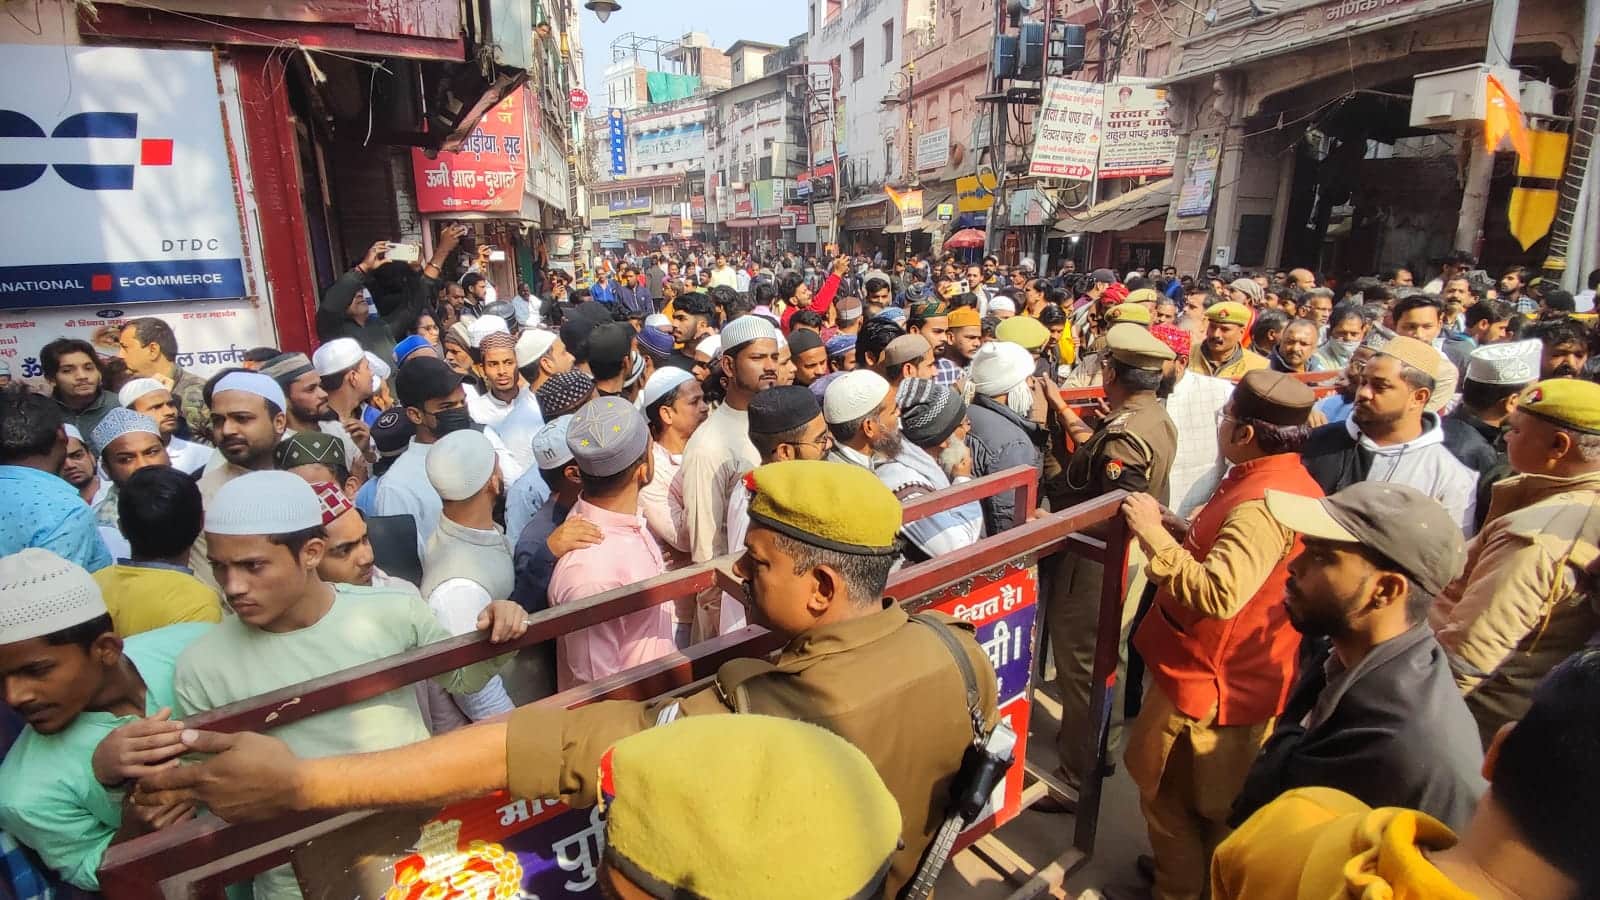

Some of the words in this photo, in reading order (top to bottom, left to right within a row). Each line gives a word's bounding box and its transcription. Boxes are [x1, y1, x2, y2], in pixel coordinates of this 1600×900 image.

[1109, 110, 1151, 119] सरदार
[503, 135, 521, 162] सूट
[424, 162, 449, 188] ऊनी
[162, 238, 219, 252] DTDC
[119, 273, 222, 288] E-COMMERCE
